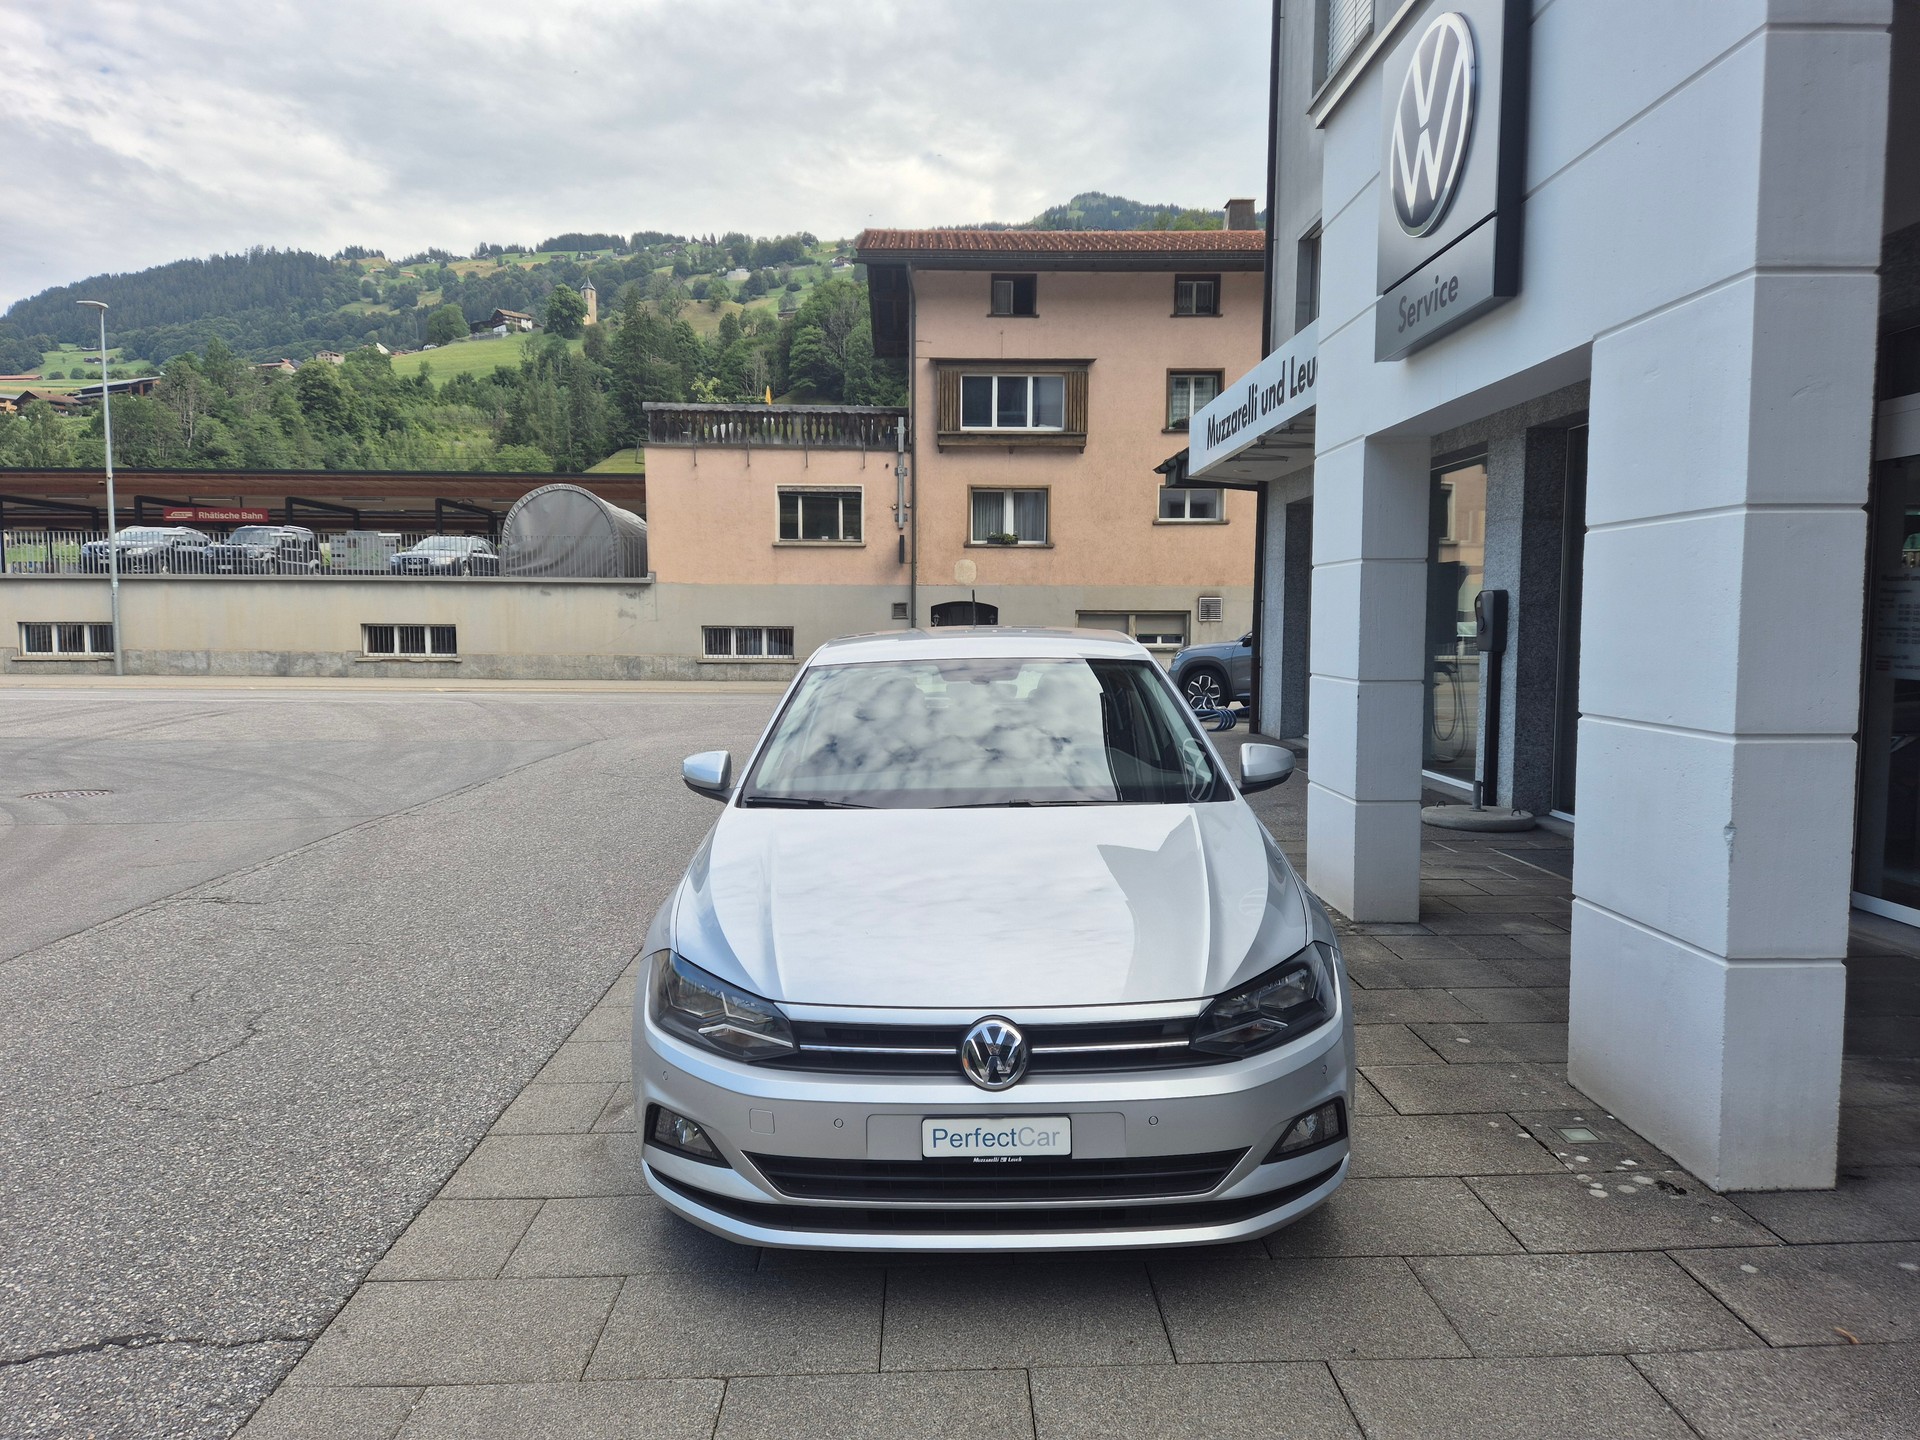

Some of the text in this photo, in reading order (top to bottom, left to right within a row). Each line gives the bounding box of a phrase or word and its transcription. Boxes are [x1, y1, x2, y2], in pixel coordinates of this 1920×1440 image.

[1398, 274, 1459, 334] Service
[1206, 355, 1319, 451] Muzzarelli und Leu
[198, 511, 263, 520] Rhätische Bahn
[932, 1126, 1061, 1148] PerfectCar
